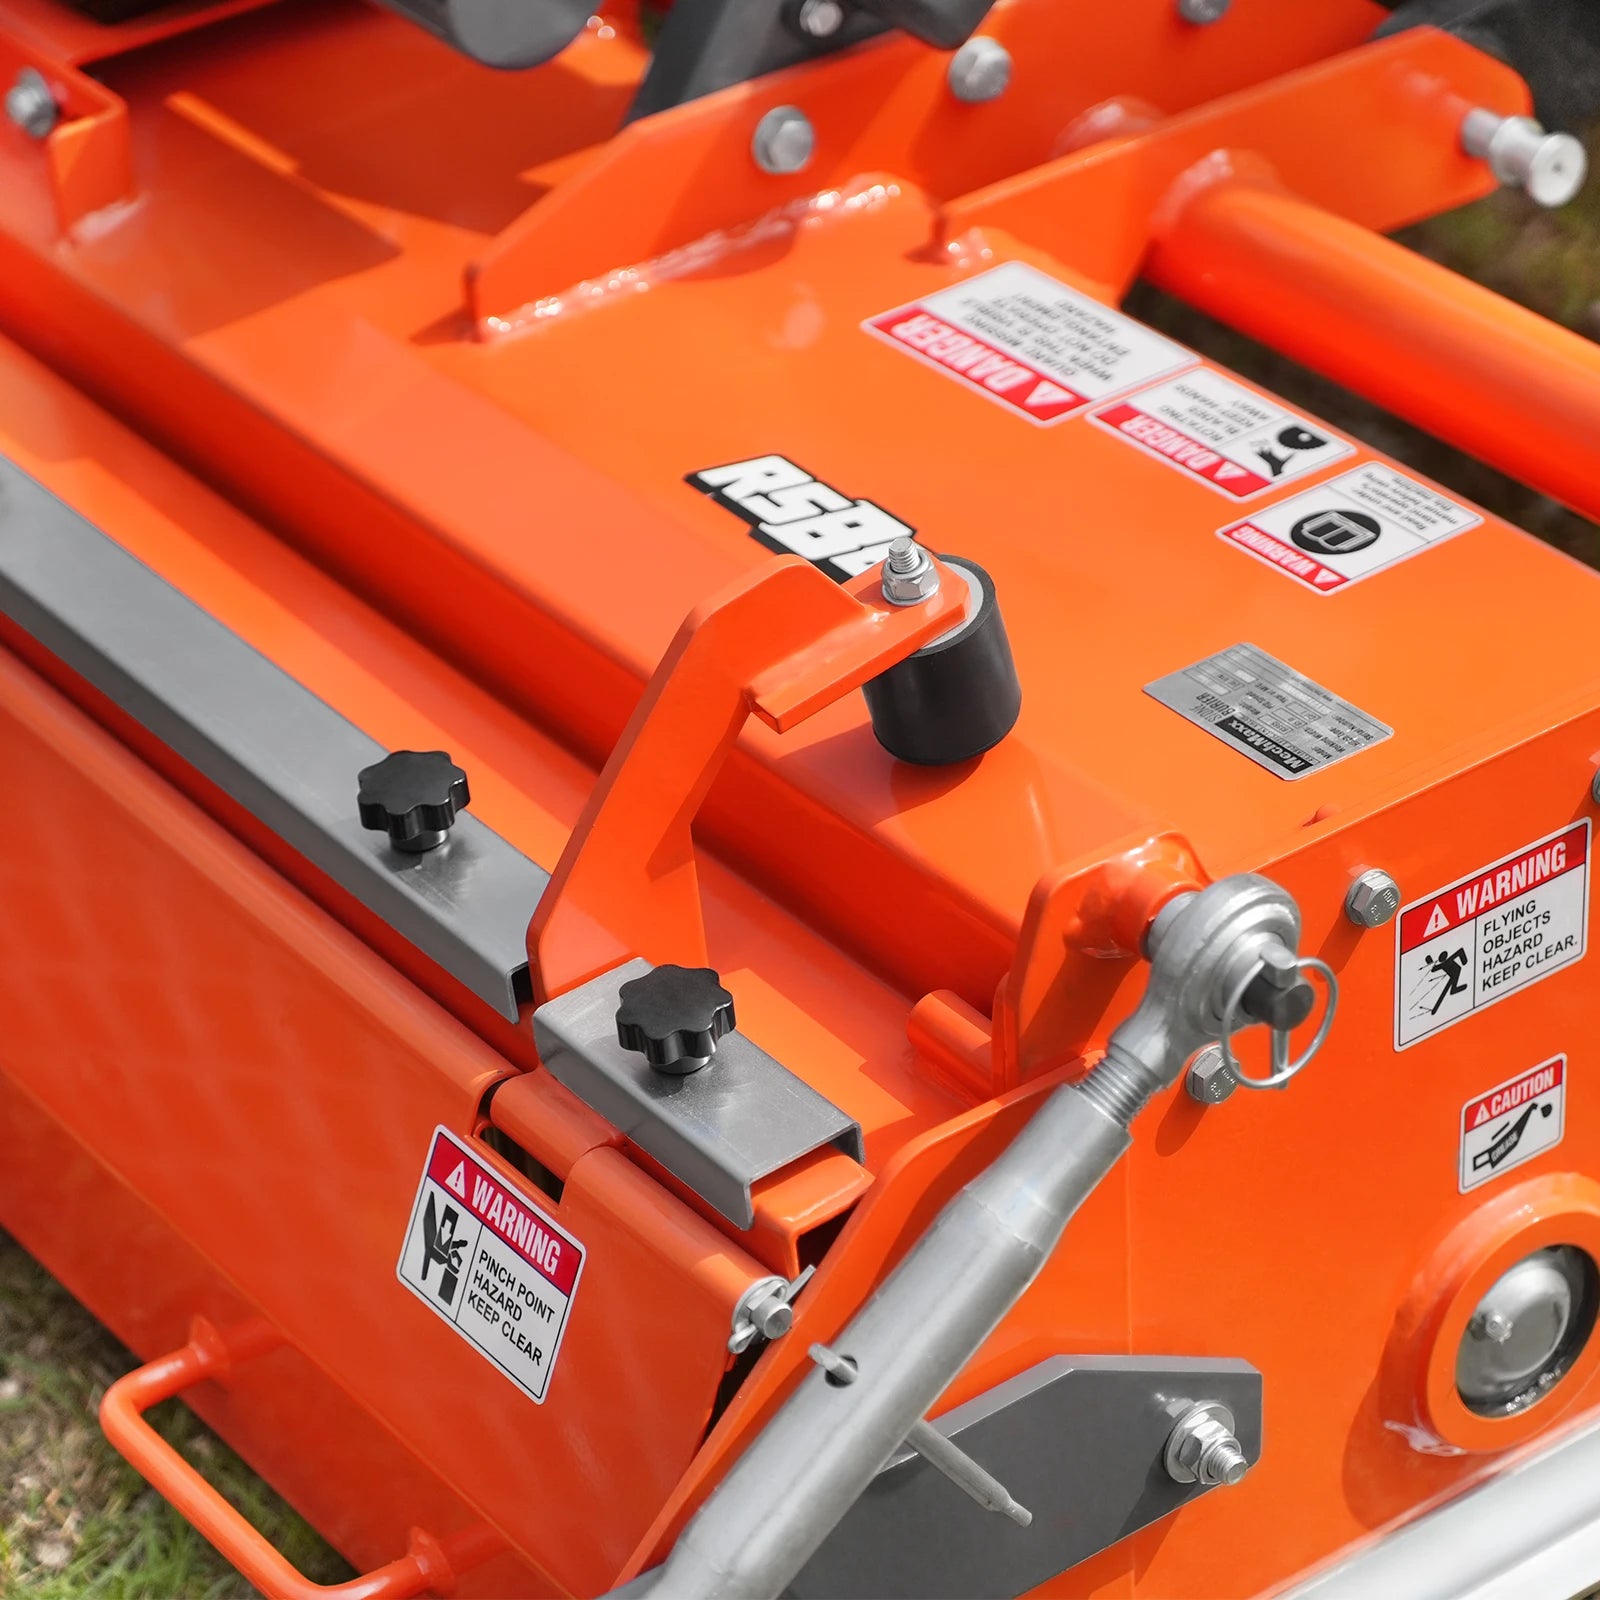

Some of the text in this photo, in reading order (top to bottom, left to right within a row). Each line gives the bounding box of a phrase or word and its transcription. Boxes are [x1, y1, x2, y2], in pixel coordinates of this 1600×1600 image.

[959, 297, 1017, 327] VISIBLE
[990, 297, 1118, 365] DO NOT OPERATE
[1010, 292, 1131, 356] ENTANGLEMENT
[1052, 299, 1118, 333] HAZARD
[888, 313, 1039, 392] DANGER
[960, 314, 1078, 376] GUARD MISSING
[1065, 354, 1114, 380] WHEN
[1156, 404, 1224, 441] ROTATING
[1173, 384, 1256, 427] KEEP HANDS
[1186, 405, 1240, 434] BLADES
[1230, 399, 1271, 421] AWAY
[1117, 413, 1224, 468] DANGER
[1382, 504, 1401, 515] and
[1387, 487, 1421, 505] before
[1400, 515, 1427, 530] Read
[1231, 525, 1321, 573] WARNING
[1192, 703, 1223, 722] STONE
[1194, 691, 1237, 716] BURIER
[1228, 719, 1306, 768] MechMaxx
[1456, 842, 1566, 919] WARNING
[1483, 898, 1536, 936] FLYING
[1483, 909, 1550, 955] OBJECTS
[1482, 932, 1577, 991] KEEP CLEAR.
[1483, 931, 1542, 973] HAZARD
[1491, 1064, 1553, 1117] CAUTION
[471, 1174, 561, 1276] WARNING
[472, 1269, 523, 1323] HAZARD
[478, 1249, 554, 1325] PINCH POINT
[467, 1289, 543, 1367] KEEP CLEAR
